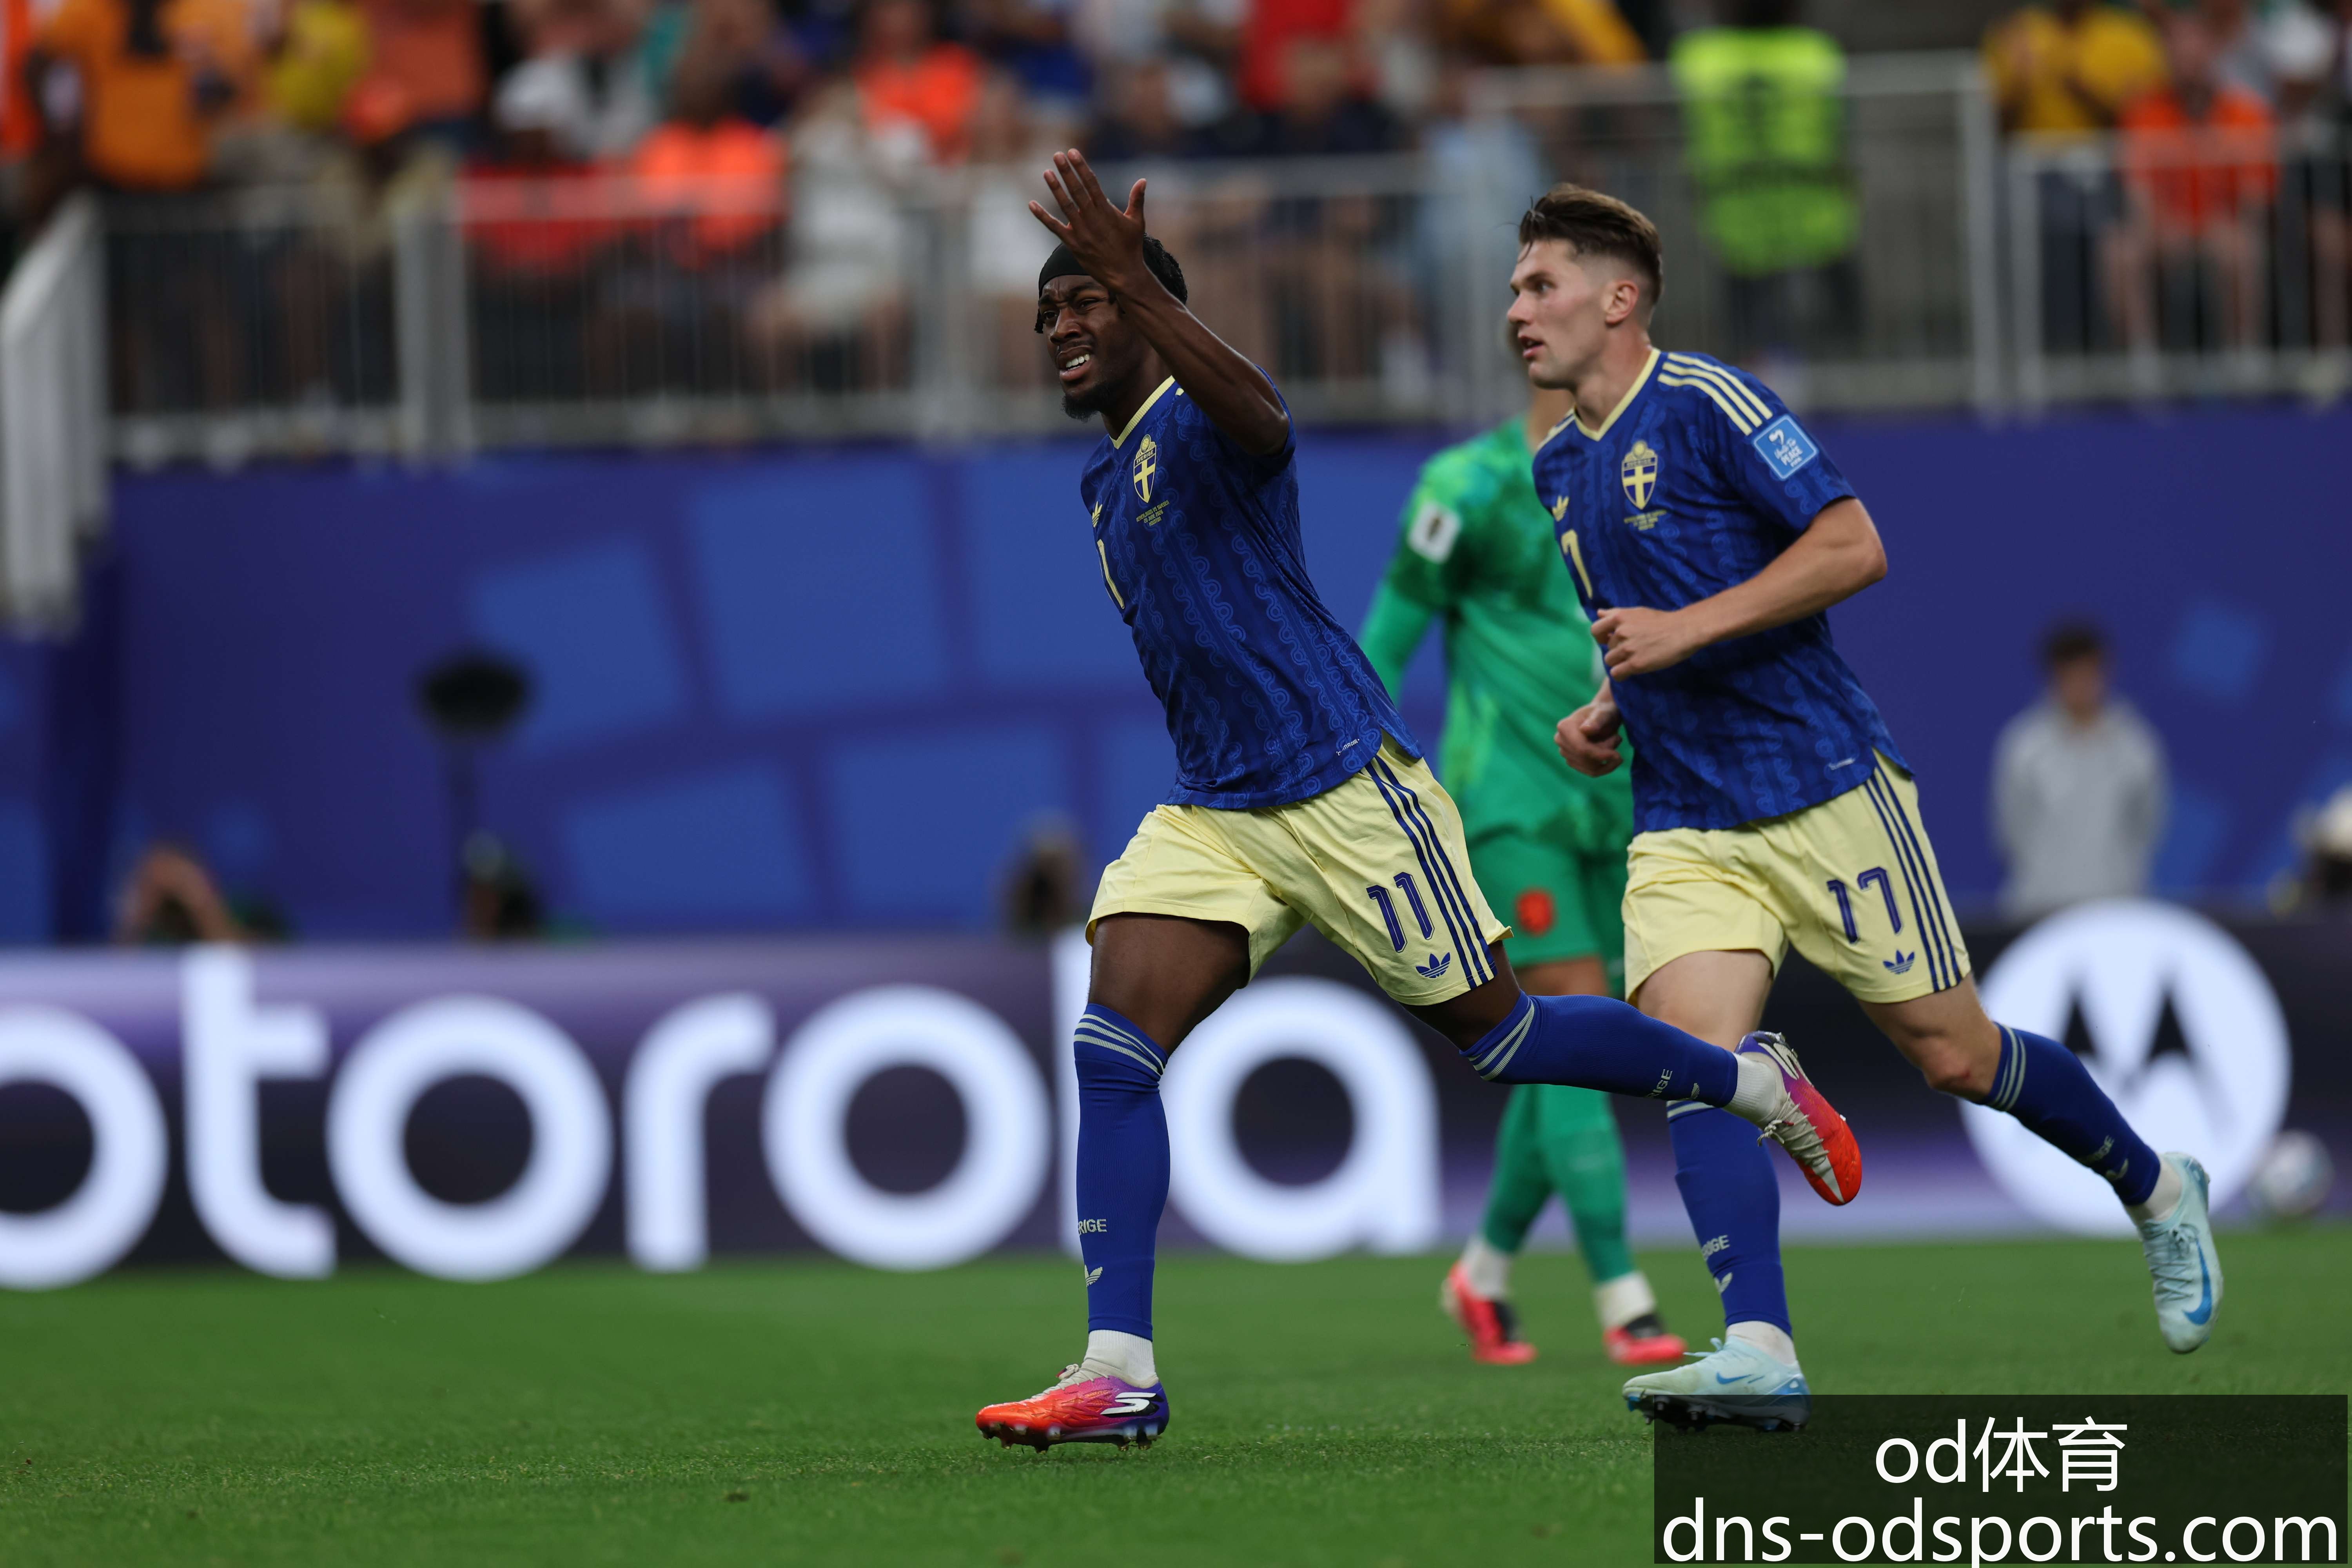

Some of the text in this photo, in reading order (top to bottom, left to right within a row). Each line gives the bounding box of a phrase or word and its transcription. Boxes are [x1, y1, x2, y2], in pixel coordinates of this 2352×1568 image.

[1136, 450, 1154, 464] SVERIGE
[1366, 872, 1435, 953] 11
[1826, 867, 1904, 945] 17
